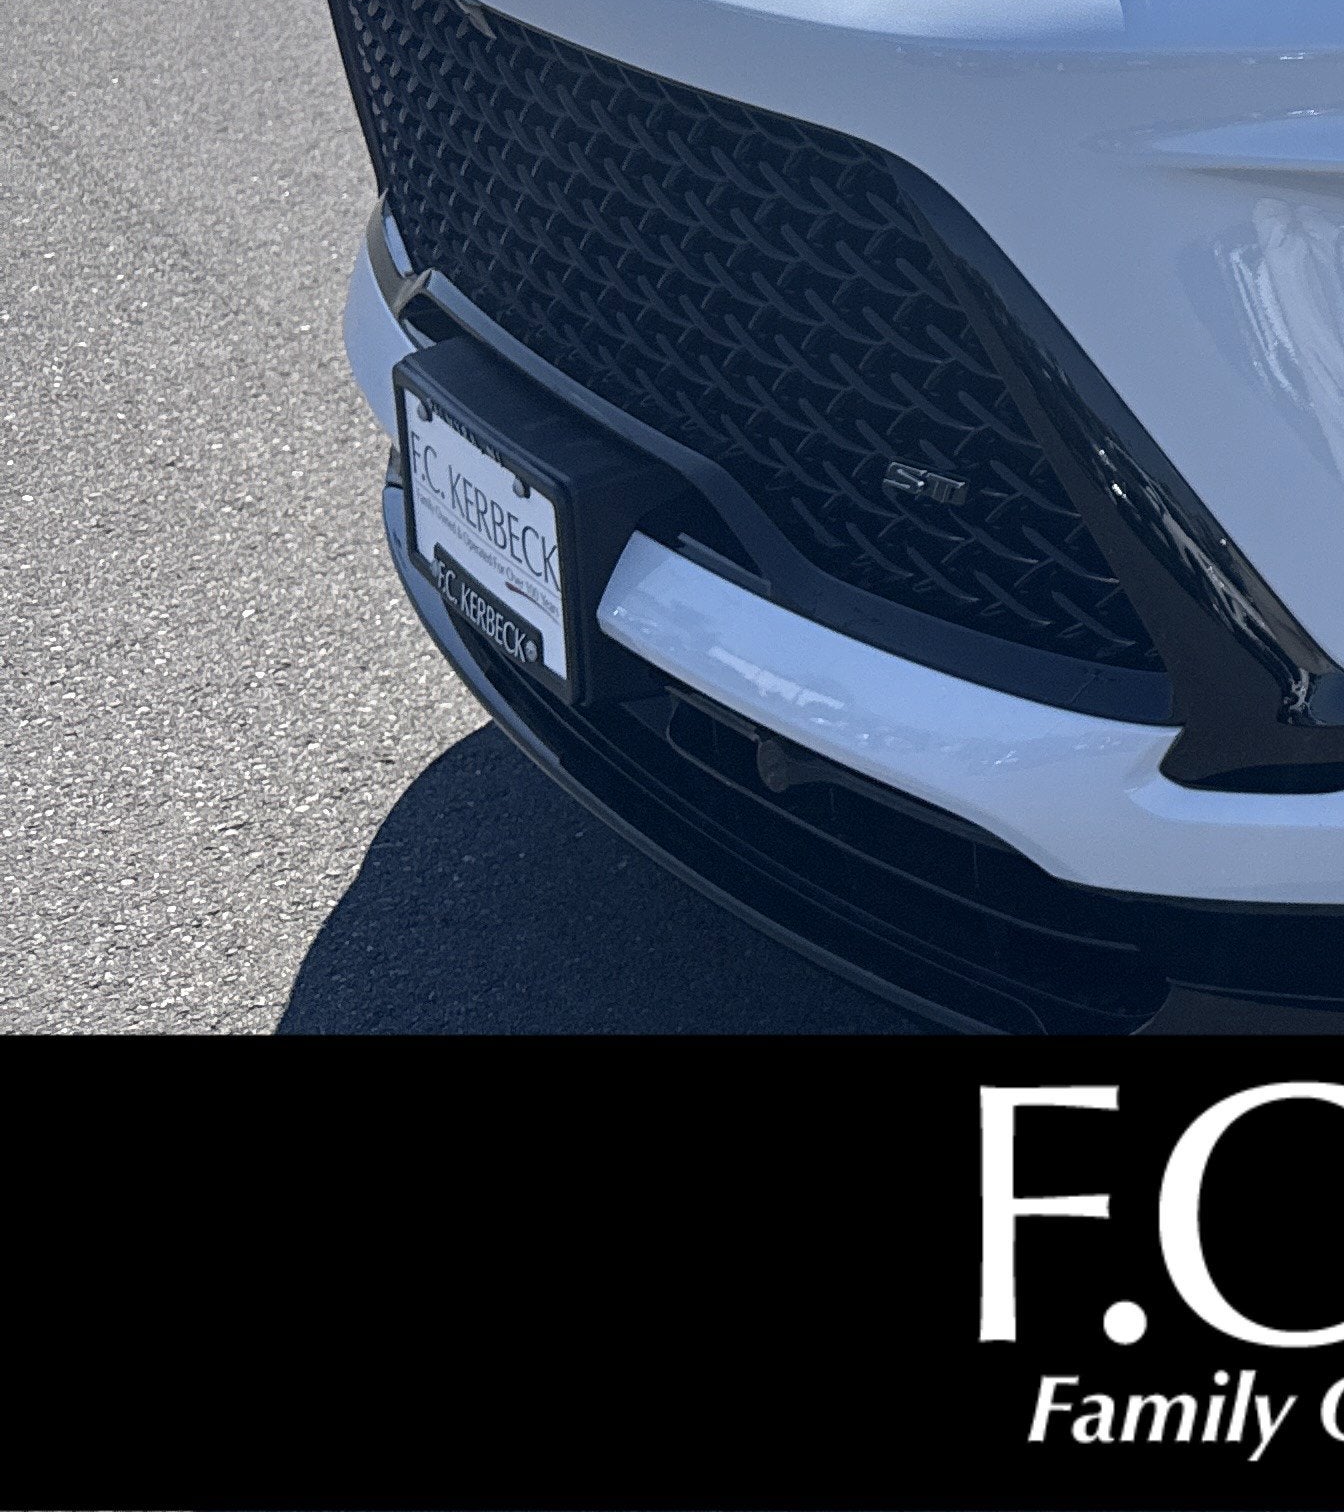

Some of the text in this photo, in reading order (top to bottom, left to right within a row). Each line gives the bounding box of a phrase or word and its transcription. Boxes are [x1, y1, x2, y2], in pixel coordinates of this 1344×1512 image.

[410, 430, 446, 500] F.C.
[448, 464, 562, 594] KERBECK
[883, 461, 967, 506] ST
[460, 582, 526, 663] KERBECK
